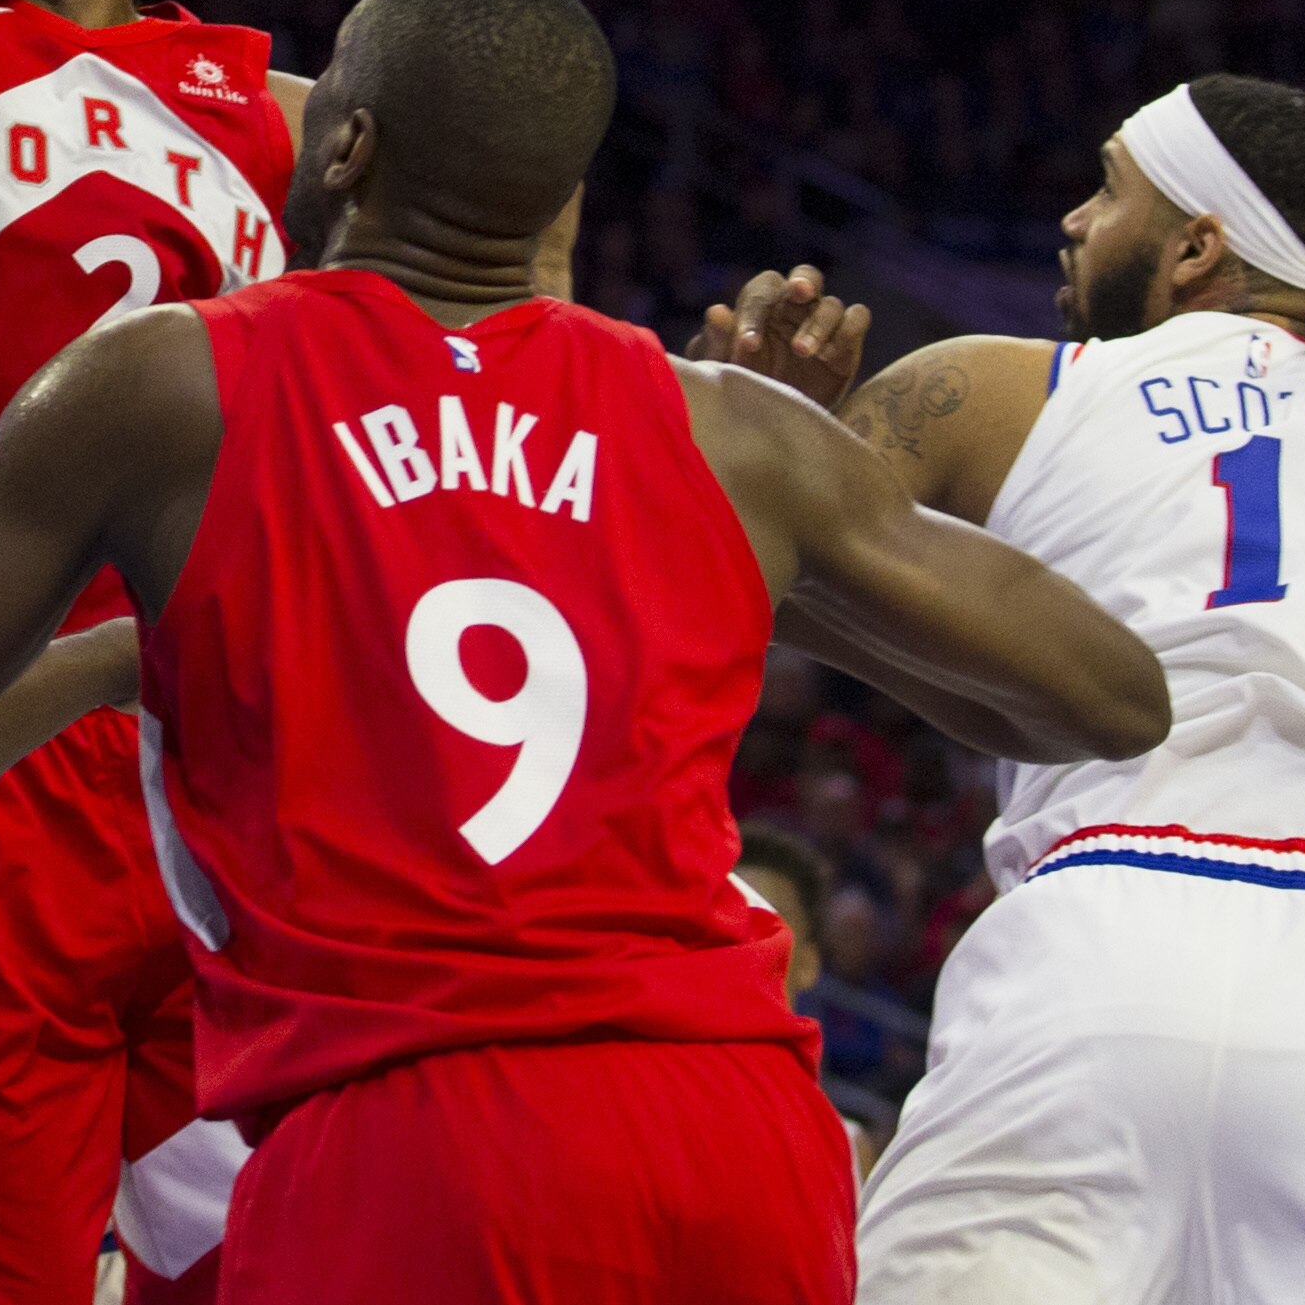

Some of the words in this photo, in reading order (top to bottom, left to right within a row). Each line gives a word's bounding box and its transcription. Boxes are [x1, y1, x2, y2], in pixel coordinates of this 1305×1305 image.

[177, 80, 214, 98] Sun
[215, 86, 249, 106] Life
[332, 395, 598, 523] IBAKA
[1204, 434, 1290, 610] 1
[404, 577, 588, 866] 9
